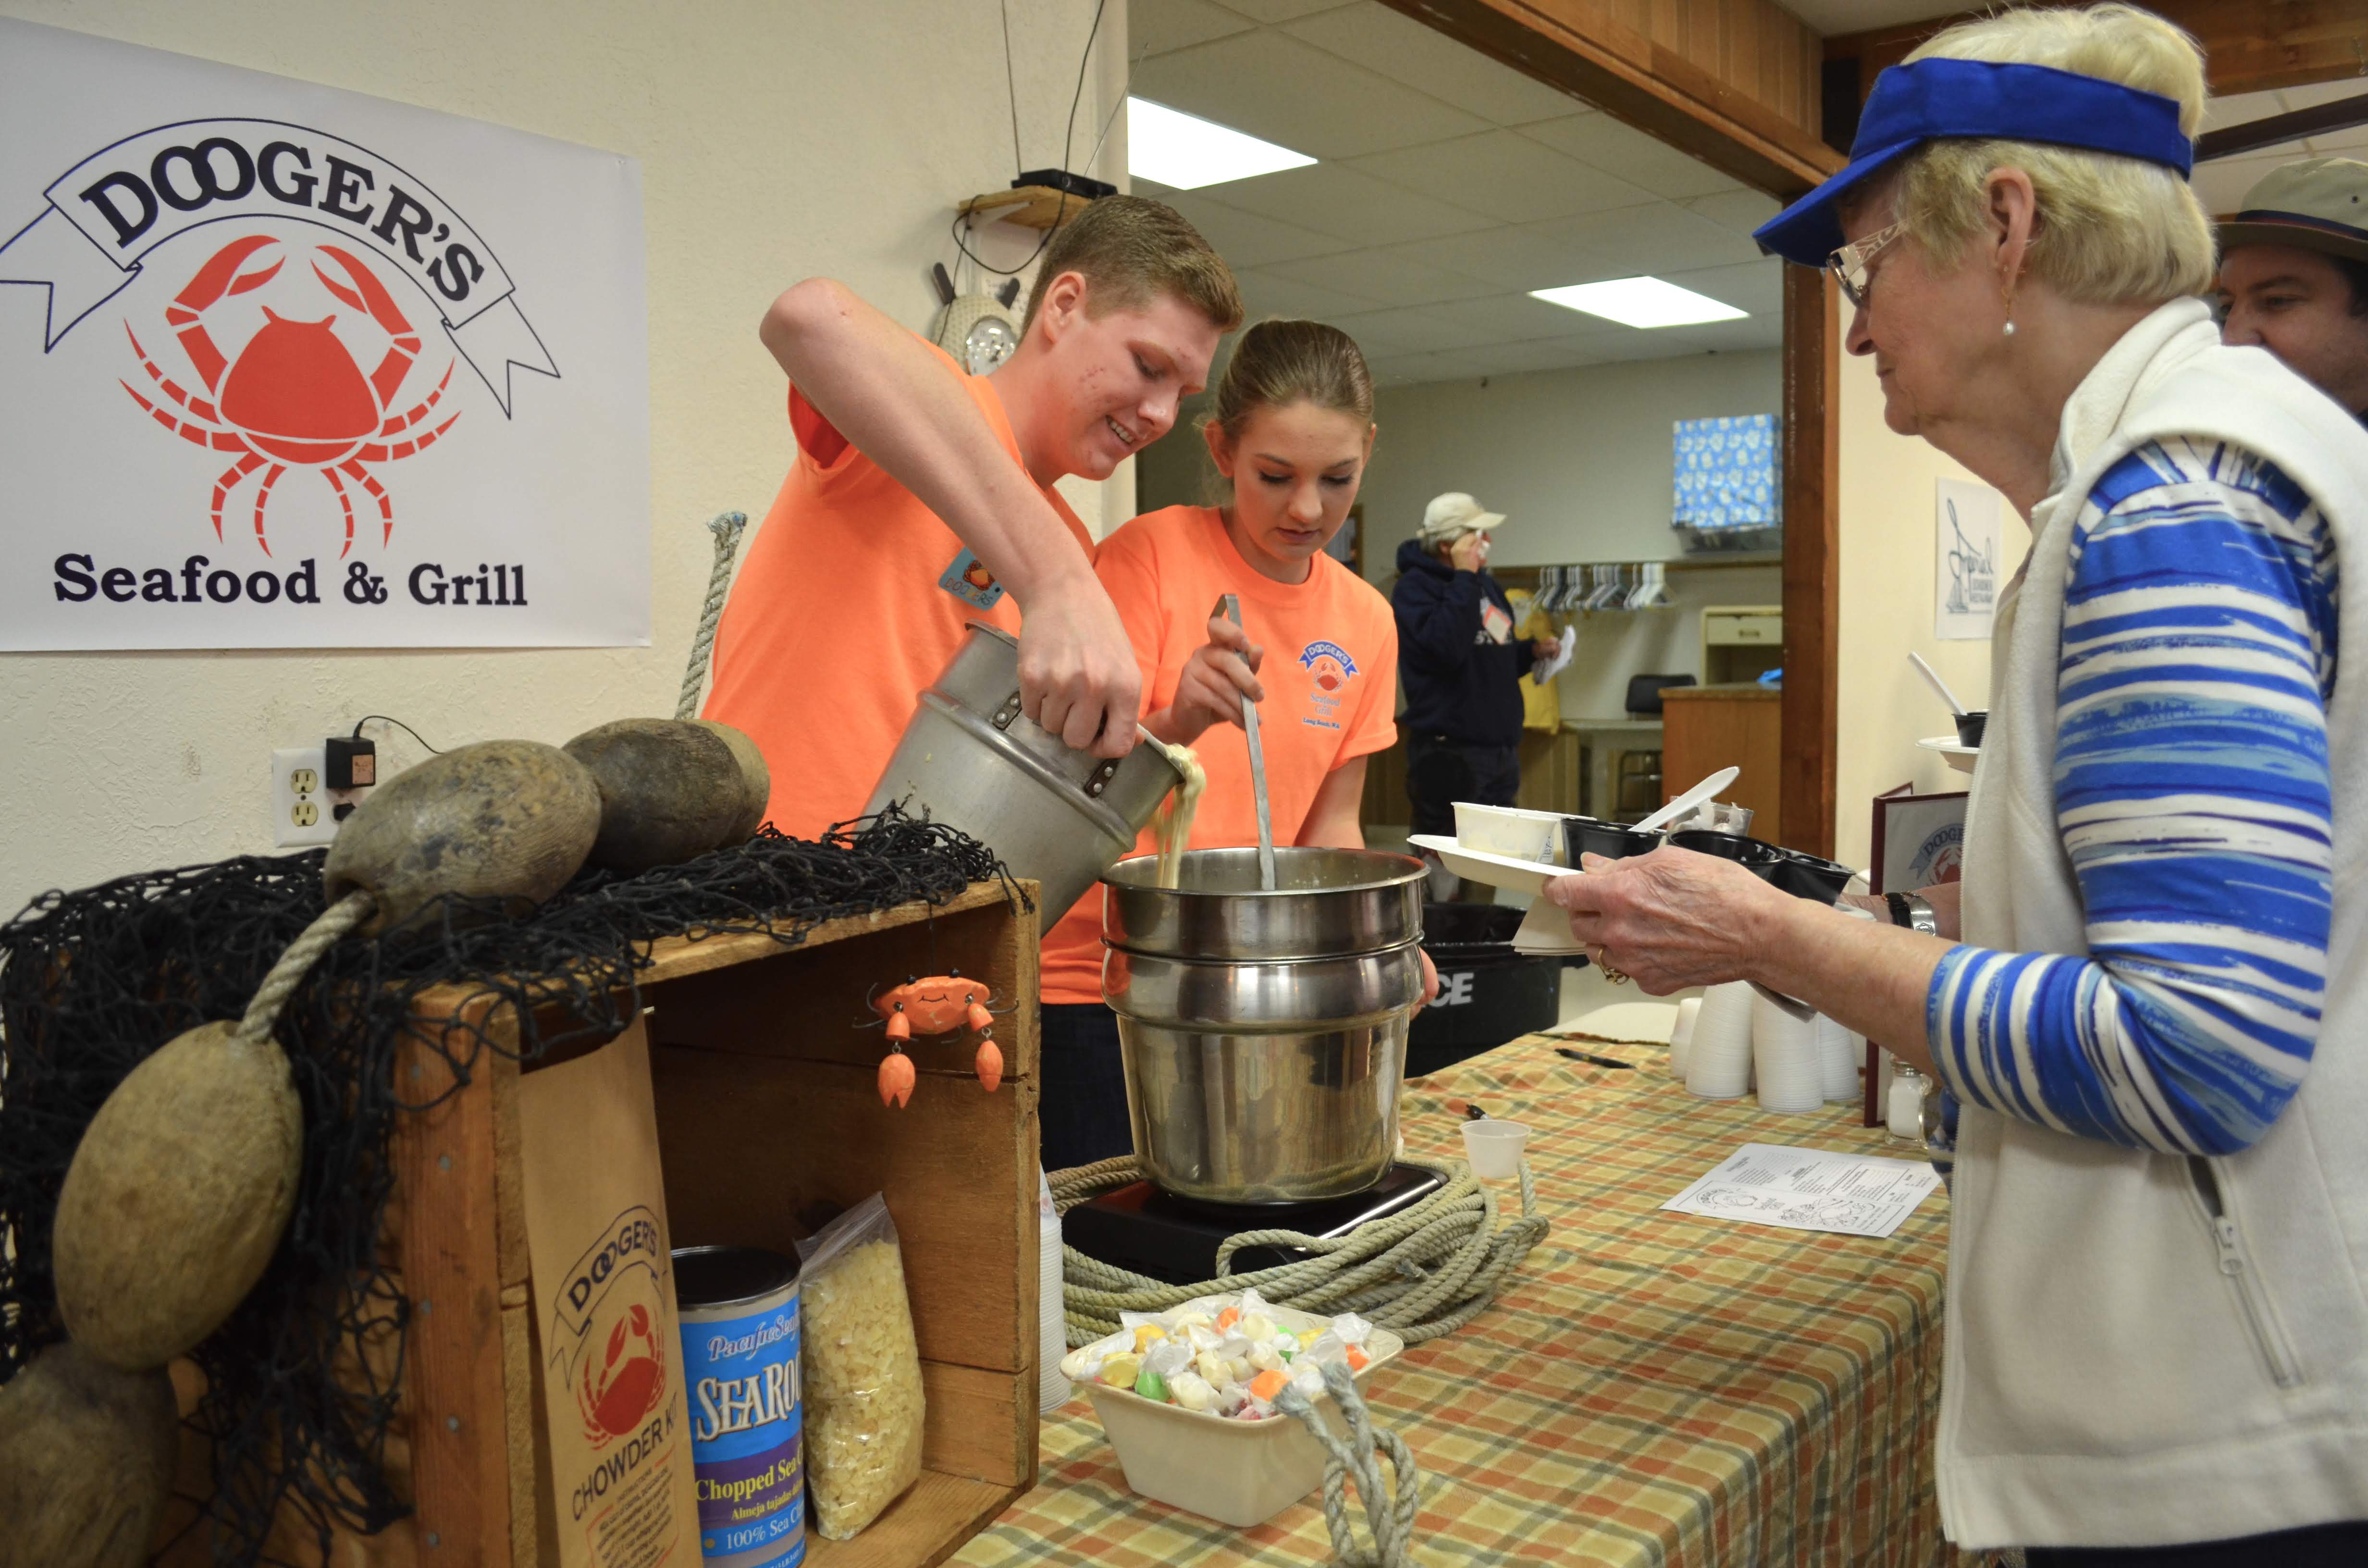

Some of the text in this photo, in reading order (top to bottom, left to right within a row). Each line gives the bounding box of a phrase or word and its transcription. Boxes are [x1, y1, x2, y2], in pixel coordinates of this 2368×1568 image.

[79, 136, 484, 302] DOOGER'S
[53, 552, 528, 606] Seafood & Grill
[1308, 644, 1349, 664] DOOGER'S
[567, 1220, 657, 1312] DOOGER'S
[573, 1417, 663, 1522] CHOWDER
[696, 1465, 775, 1502] Chopped
[778, 1458, 797, 1482] Sea
[727, 1525, 766, 1550] 100%
[770, 1518, 789, 1537] Sea
[731, 1502, 765, 1521] Almeja
